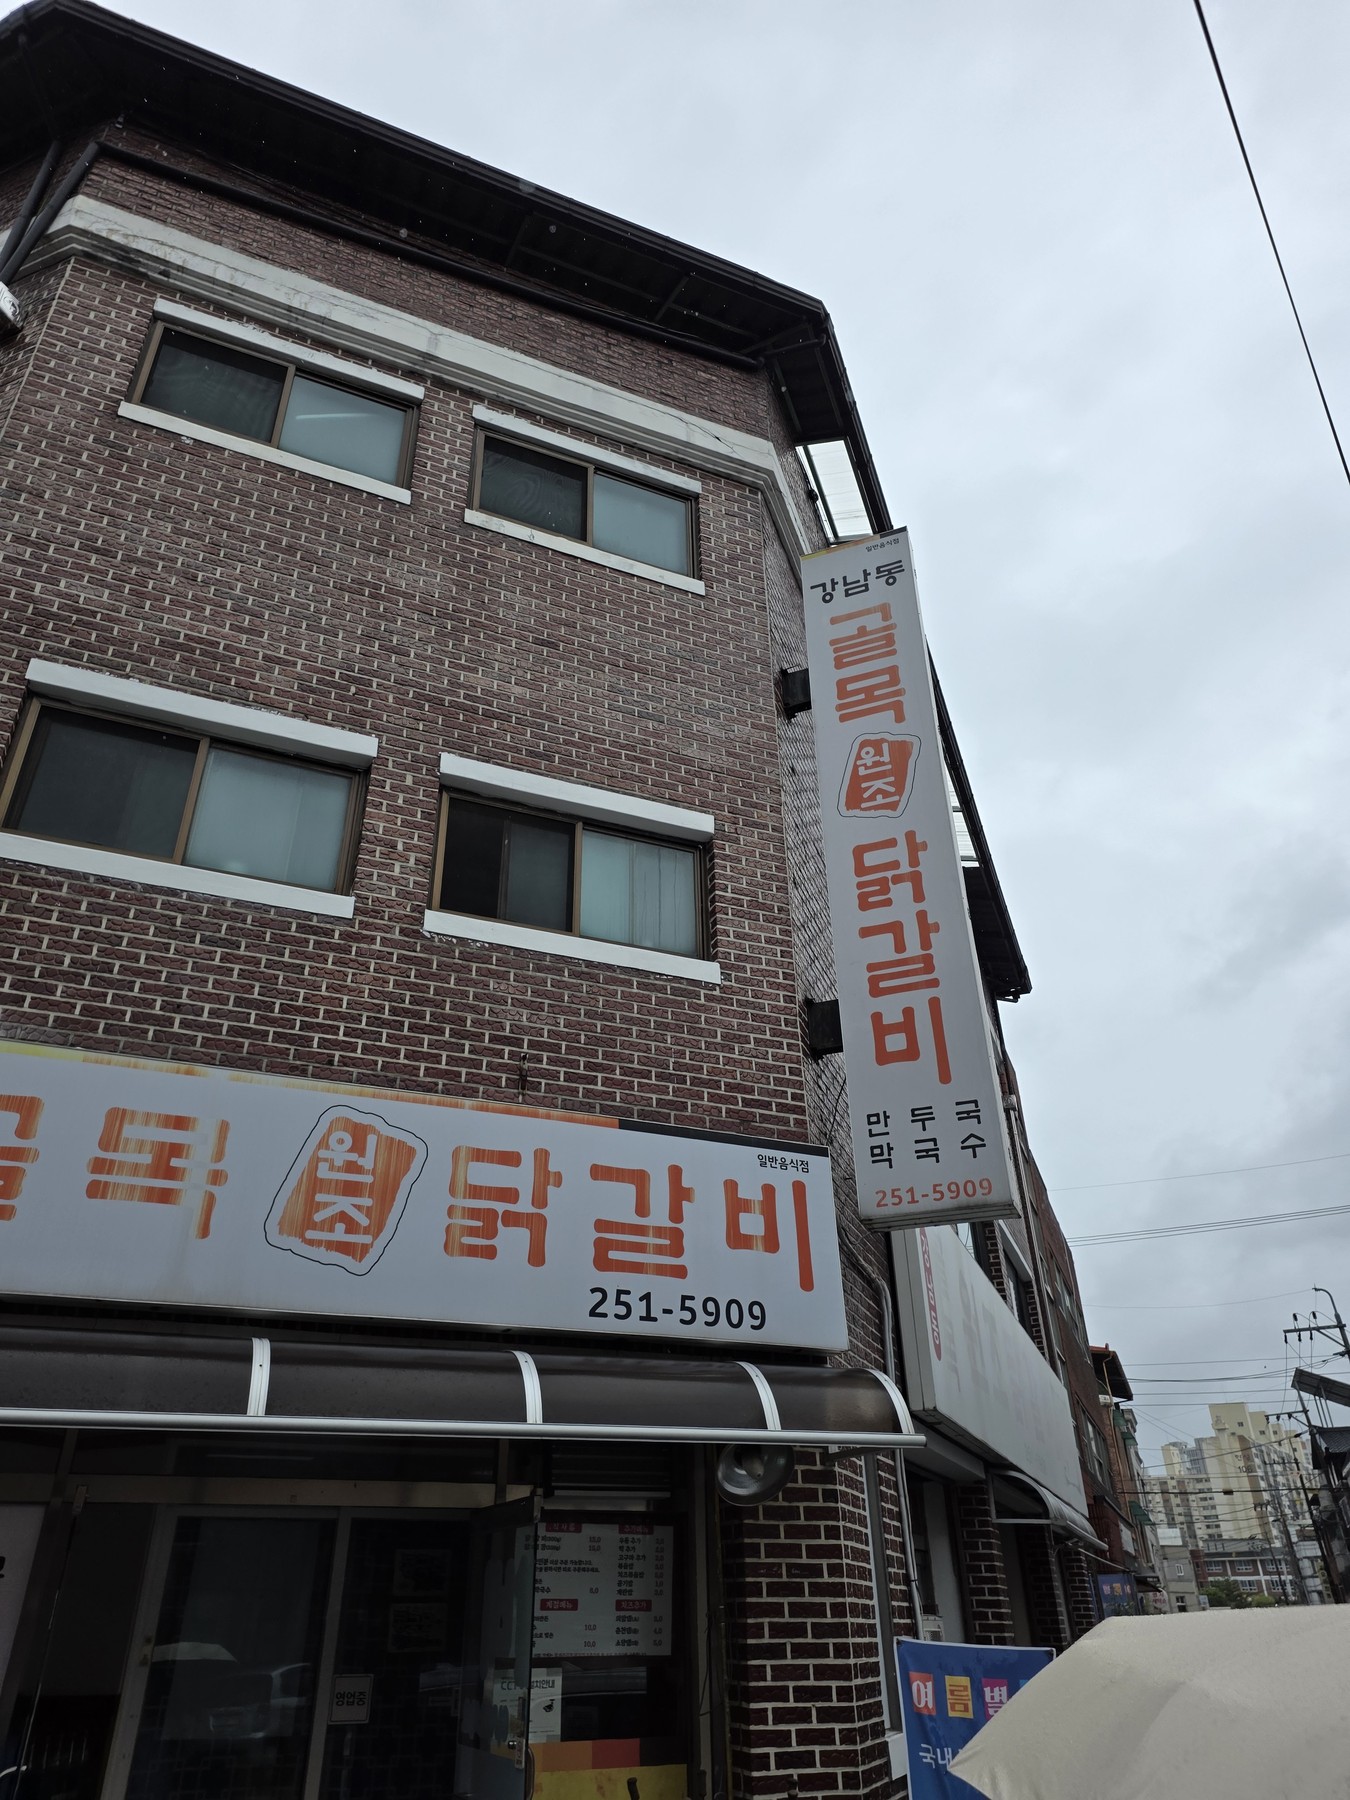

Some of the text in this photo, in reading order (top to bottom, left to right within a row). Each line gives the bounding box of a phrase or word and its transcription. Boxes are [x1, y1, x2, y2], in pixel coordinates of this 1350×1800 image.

[865, 537, 900, 552] 일반음식점
[810, 559, 905, 604] 강남동
[829, 602, 952, 1085] 골목 원조 닭갈비
[866, 1099, 981, 1138] 만두국
[756, 1153, 810, 1174] 일반음식점
[870, 1132, 986, 1169] 막국수
[304, 1130, 378, 1244] 원조
[443, 1145, 815, 1293] 닭갈비
[875, 1177, 993, 1208] 251-5909
[588, 1286, 767, 1331] 251-5909
[335, 1690, 368, 1707] 영업중
